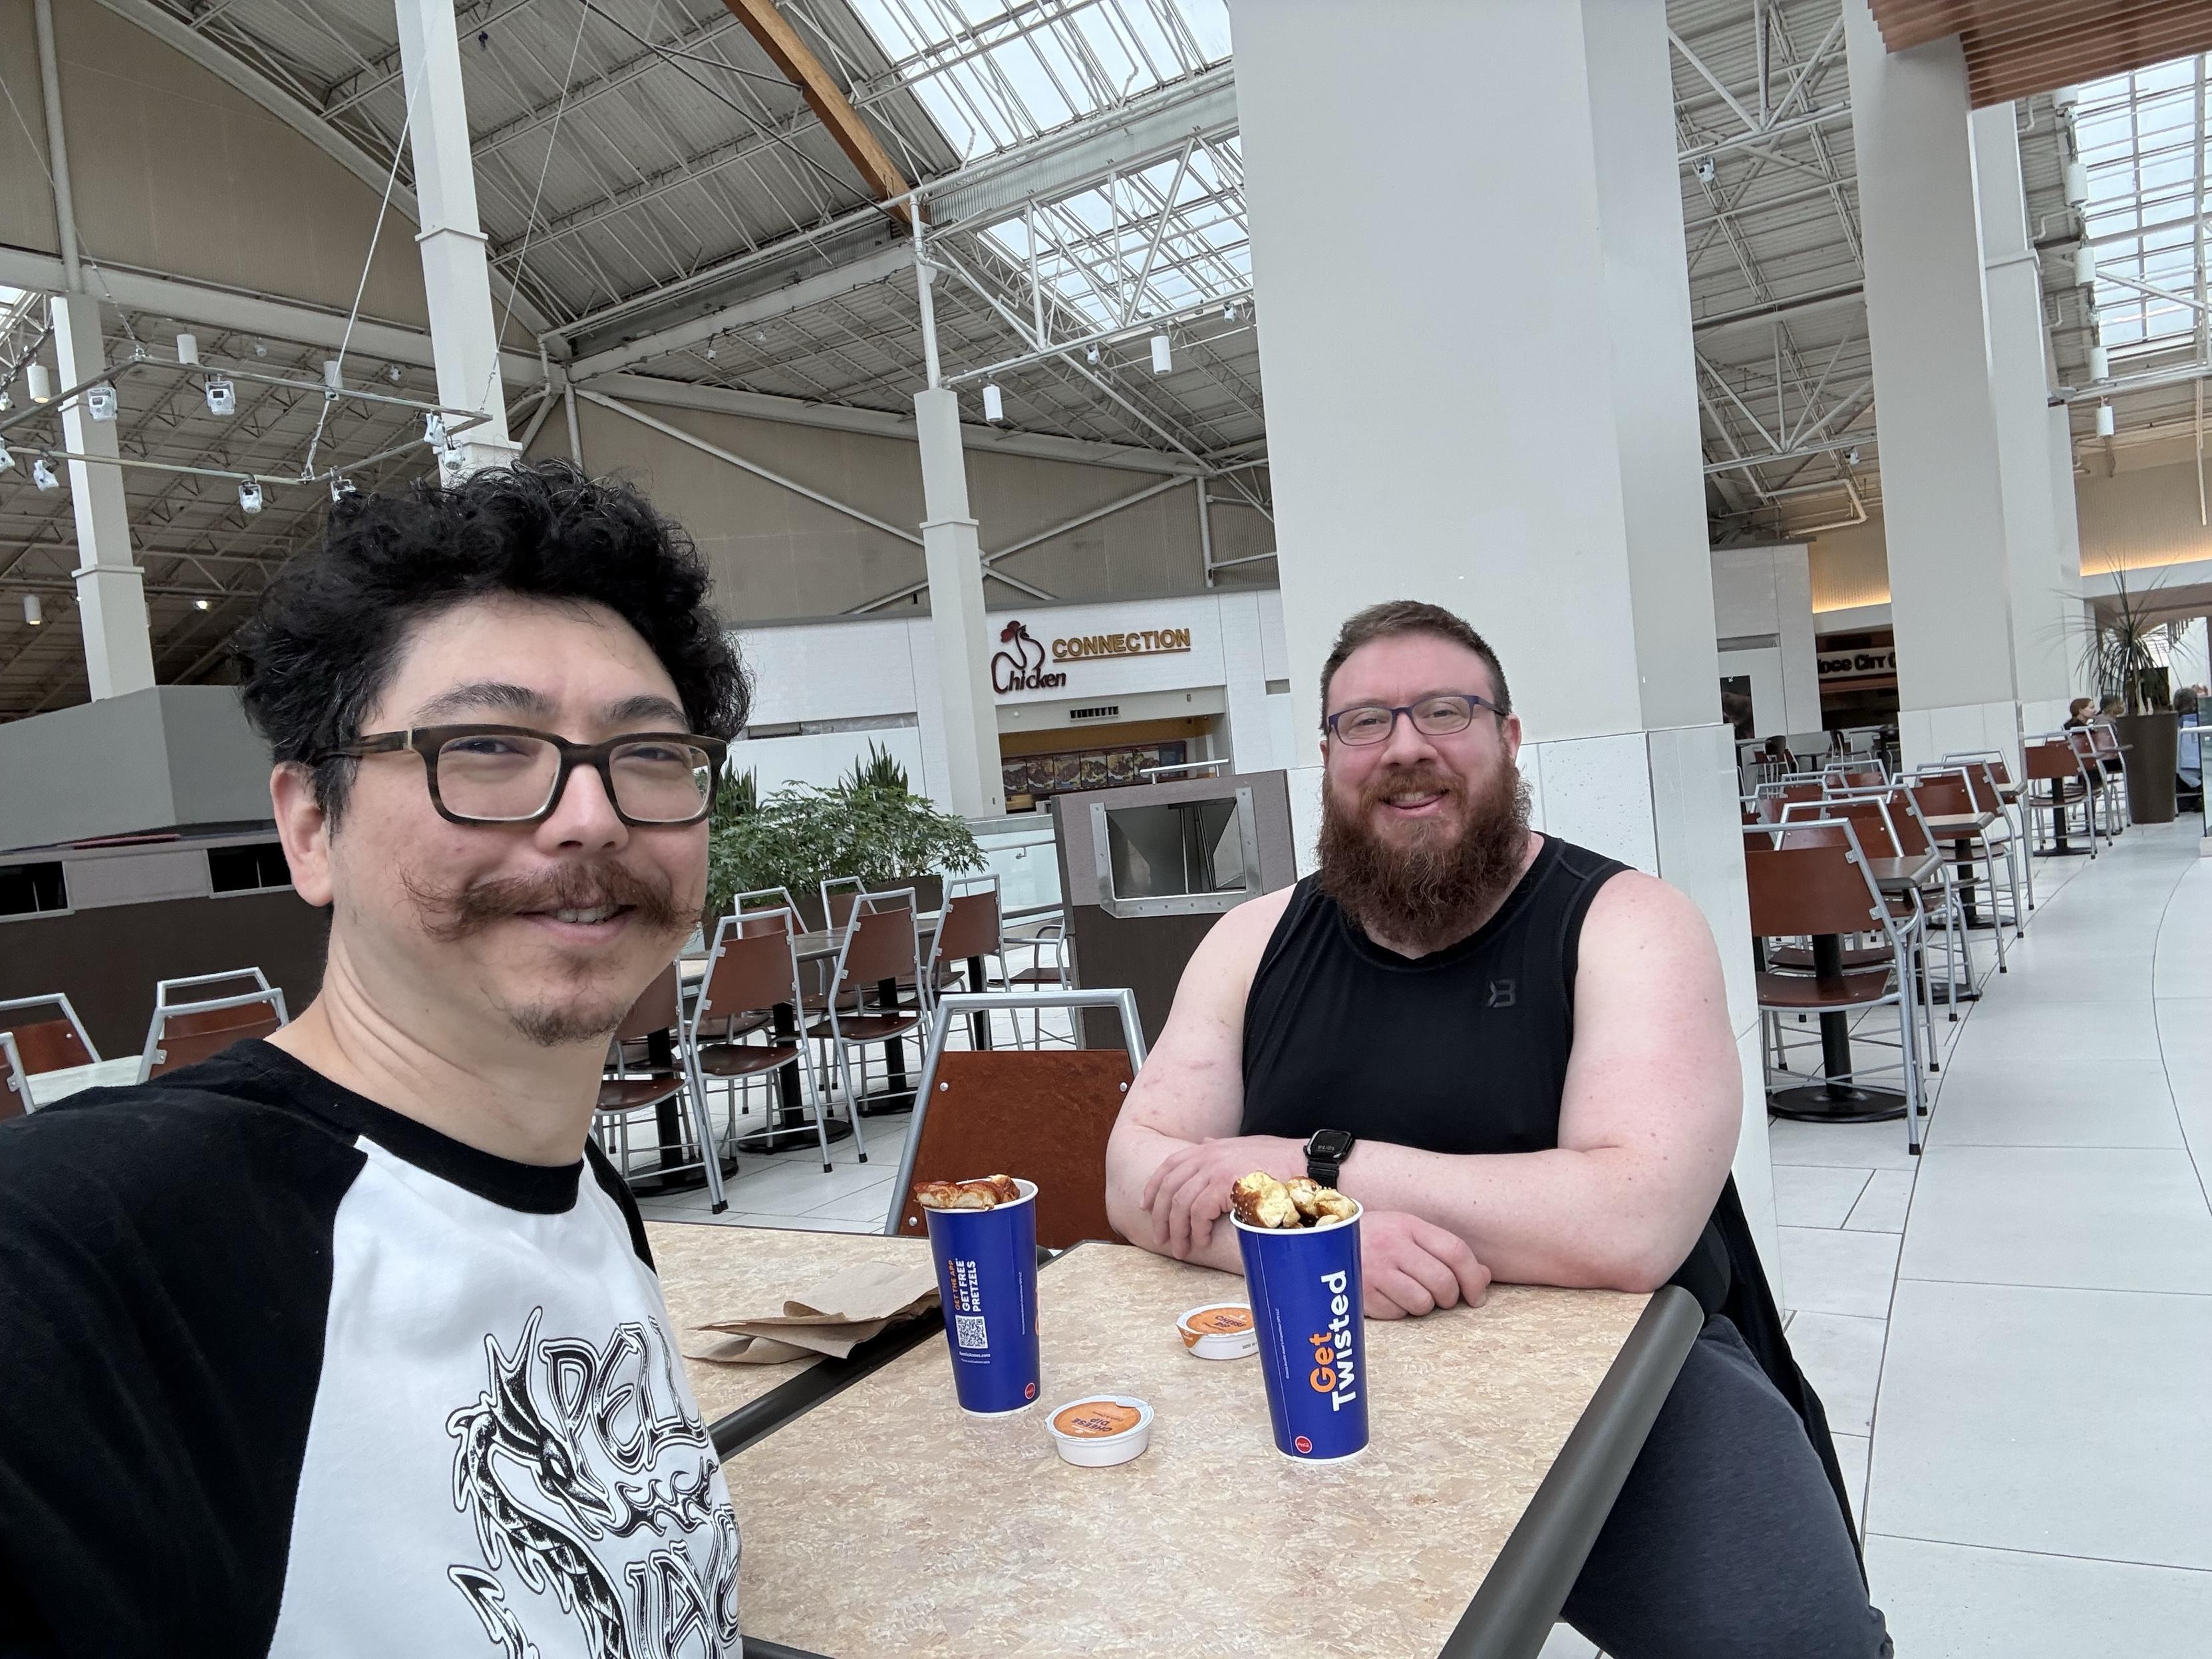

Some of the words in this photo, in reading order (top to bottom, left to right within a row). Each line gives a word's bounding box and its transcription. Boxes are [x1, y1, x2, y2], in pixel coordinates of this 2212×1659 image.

[1052, 628, 1191, 658] CONNECTION
[991, 652, 1066, 694] Chicken
[959, 1288, 971, 1312] GET
[967, 1261, 981, 1312] PRETZELS
[1321, 1270, 1356, 1412] Twisted
[1309, 1332, 1337, 1394] Get
[1071, 1418, 1112, 1432] CHEESE
